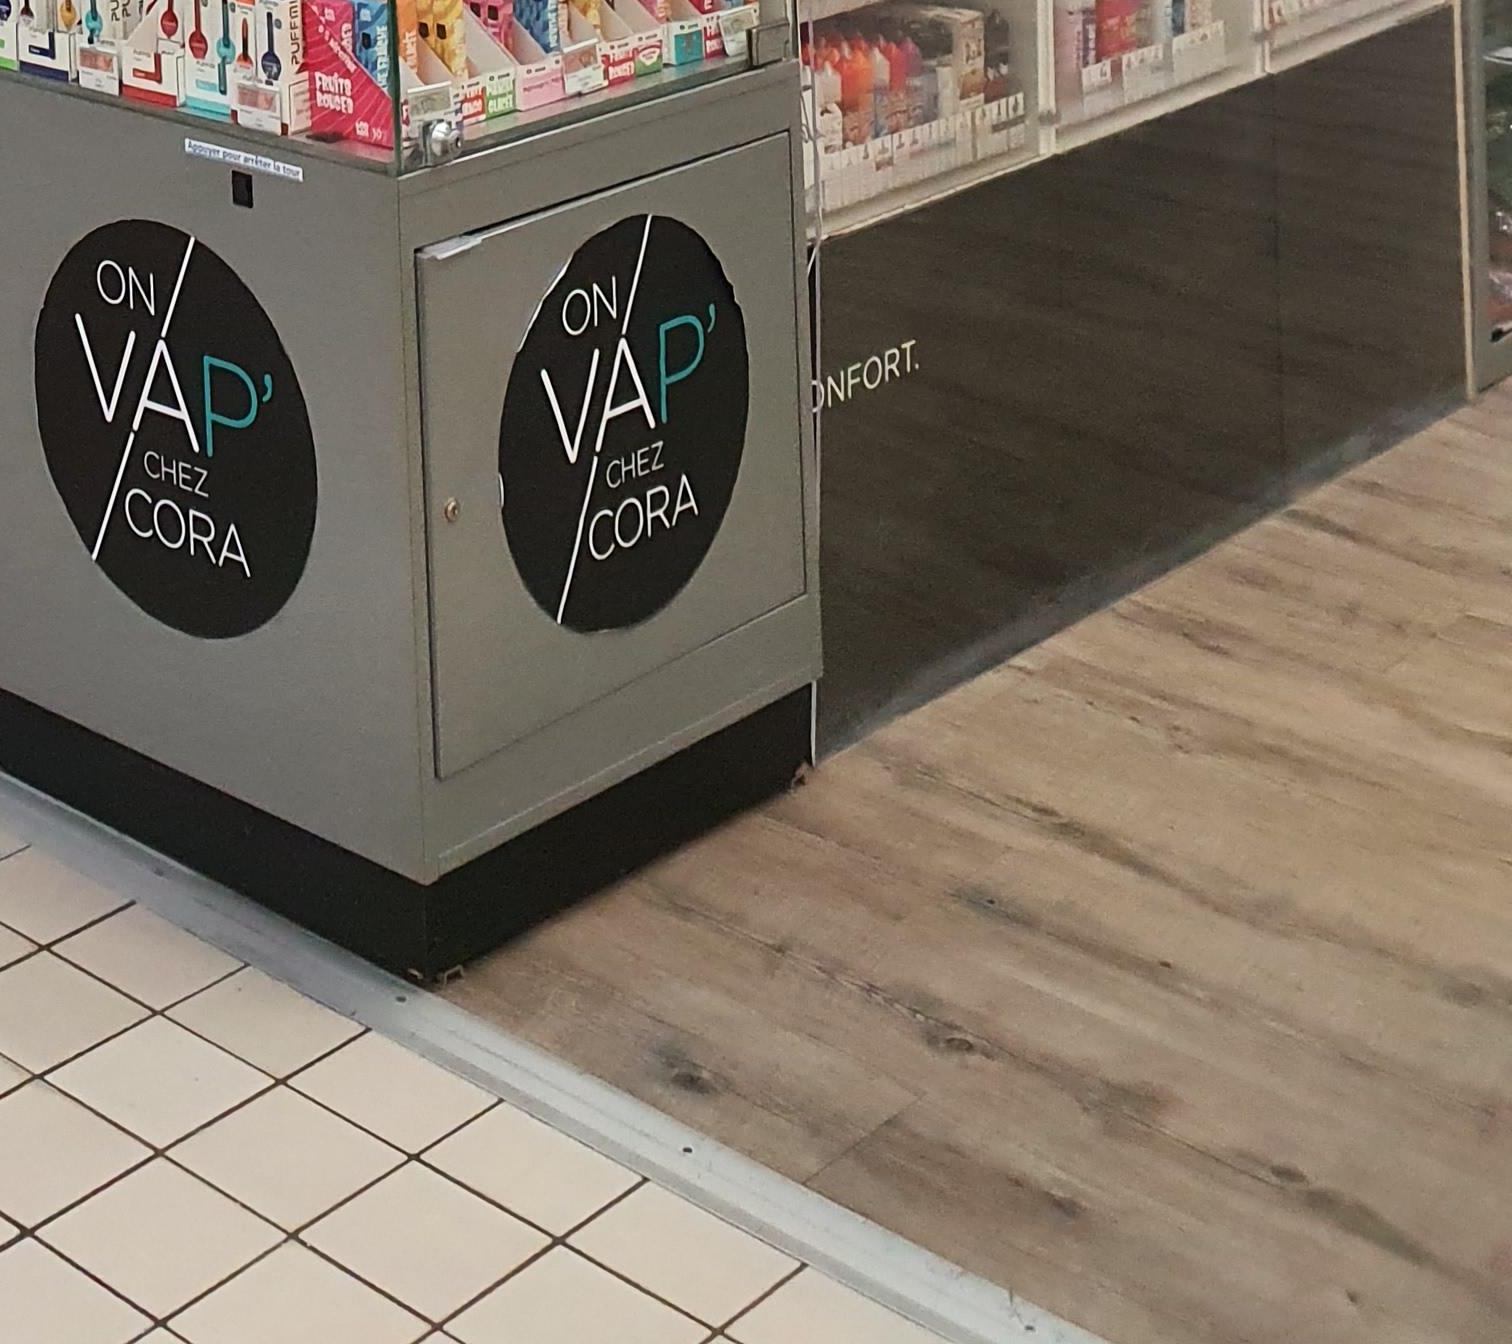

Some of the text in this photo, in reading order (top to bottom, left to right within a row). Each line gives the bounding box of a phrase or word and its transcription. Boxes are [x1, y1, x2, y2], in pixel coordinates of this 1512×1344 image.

[290, 0, 301, 66] PUFFMI
[314, 71, 352, 97] FRUITS
[316, 90, 354, 115] ROUGES
[188, 140, 301, 177] Appuyer pour arrêter la tour
[96, 259, 156, 317] ON
[561, 274, 618, 337] ON
[812, 338, 921, 414] ONFORT.
[143, 450, 210, 498] CHEZ
[605, 439, 665, 489] CHEZ
[124, 487, 251, 579] CORA
[587, 472, 700, 562] CORA
